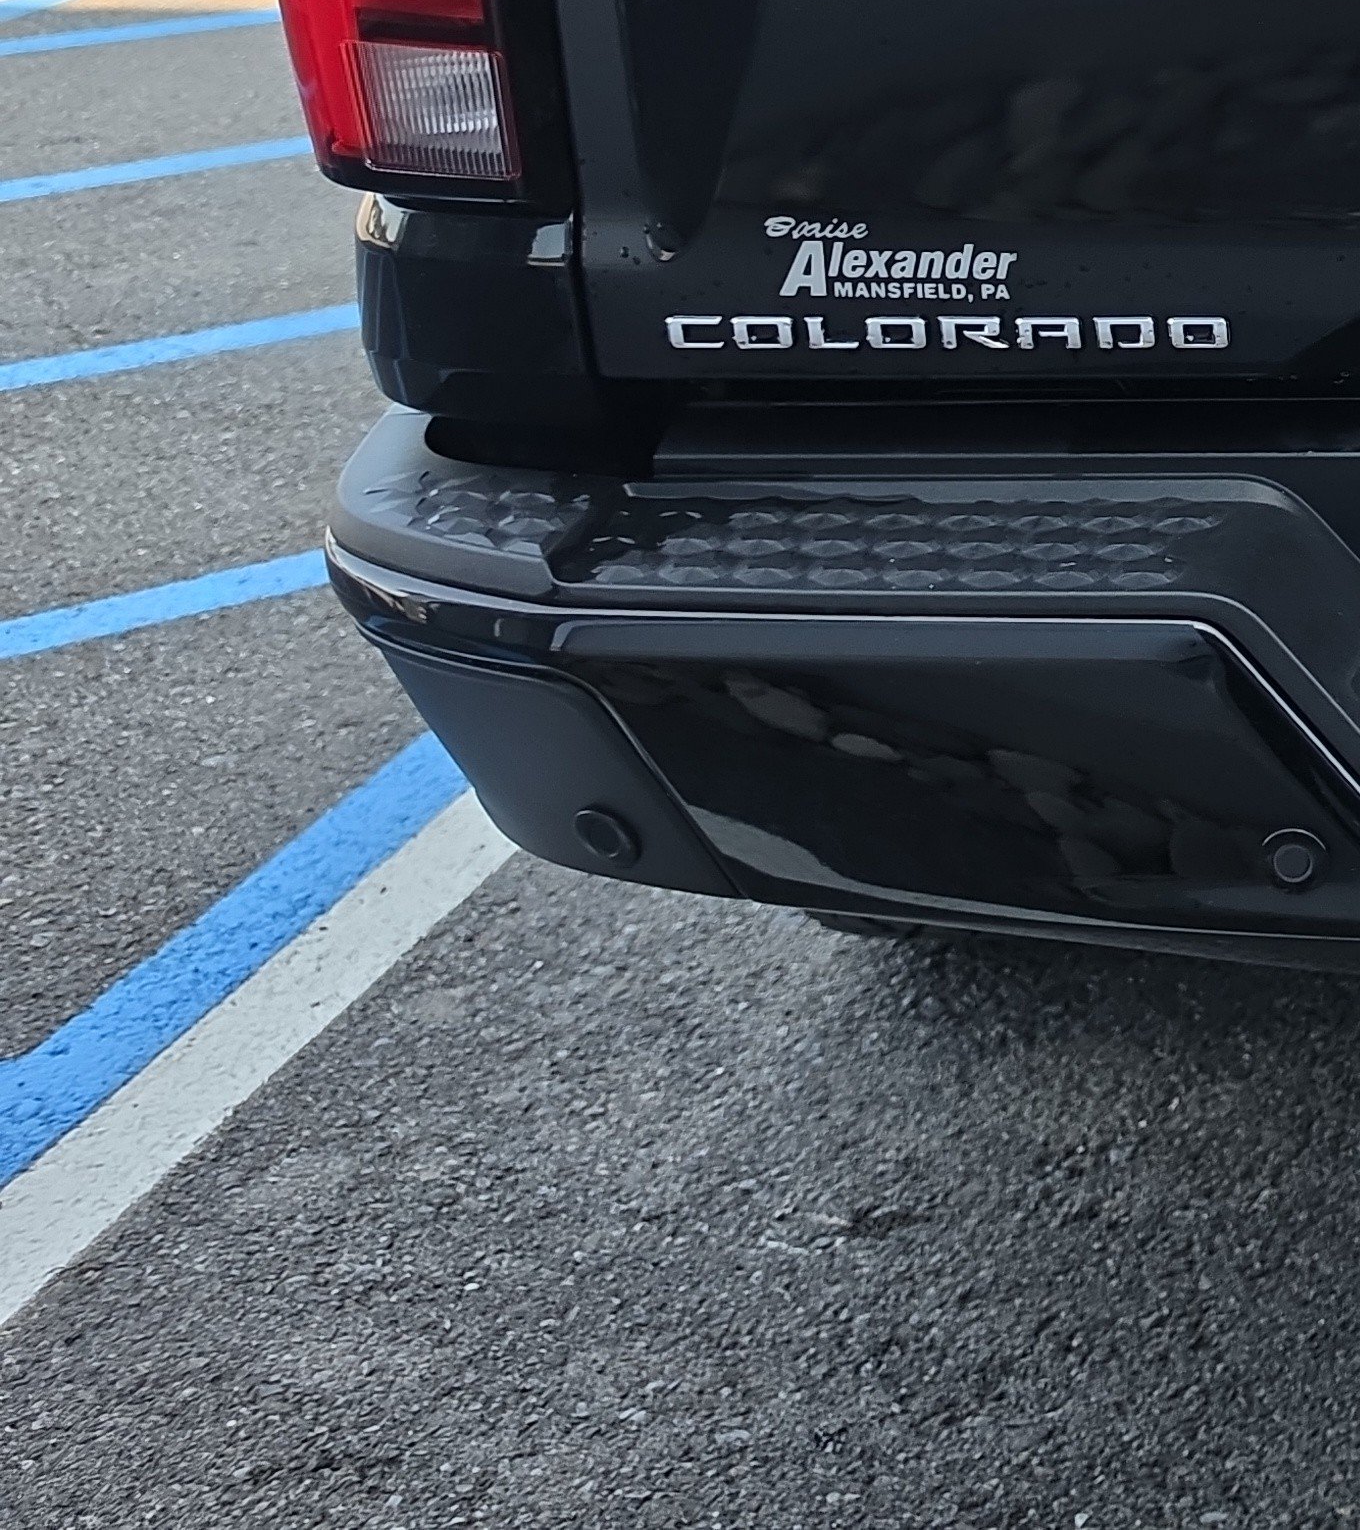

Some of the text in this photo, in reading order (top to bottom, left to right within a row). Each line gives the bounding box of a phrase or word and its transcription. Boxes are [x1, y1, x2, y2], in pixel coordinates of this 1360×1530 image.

[779, 240, 1018, 297] Alexander
[834, 281, 1011, 303] MANSFIELD, PA
[664, 314, 1232, 350] COLORADO
